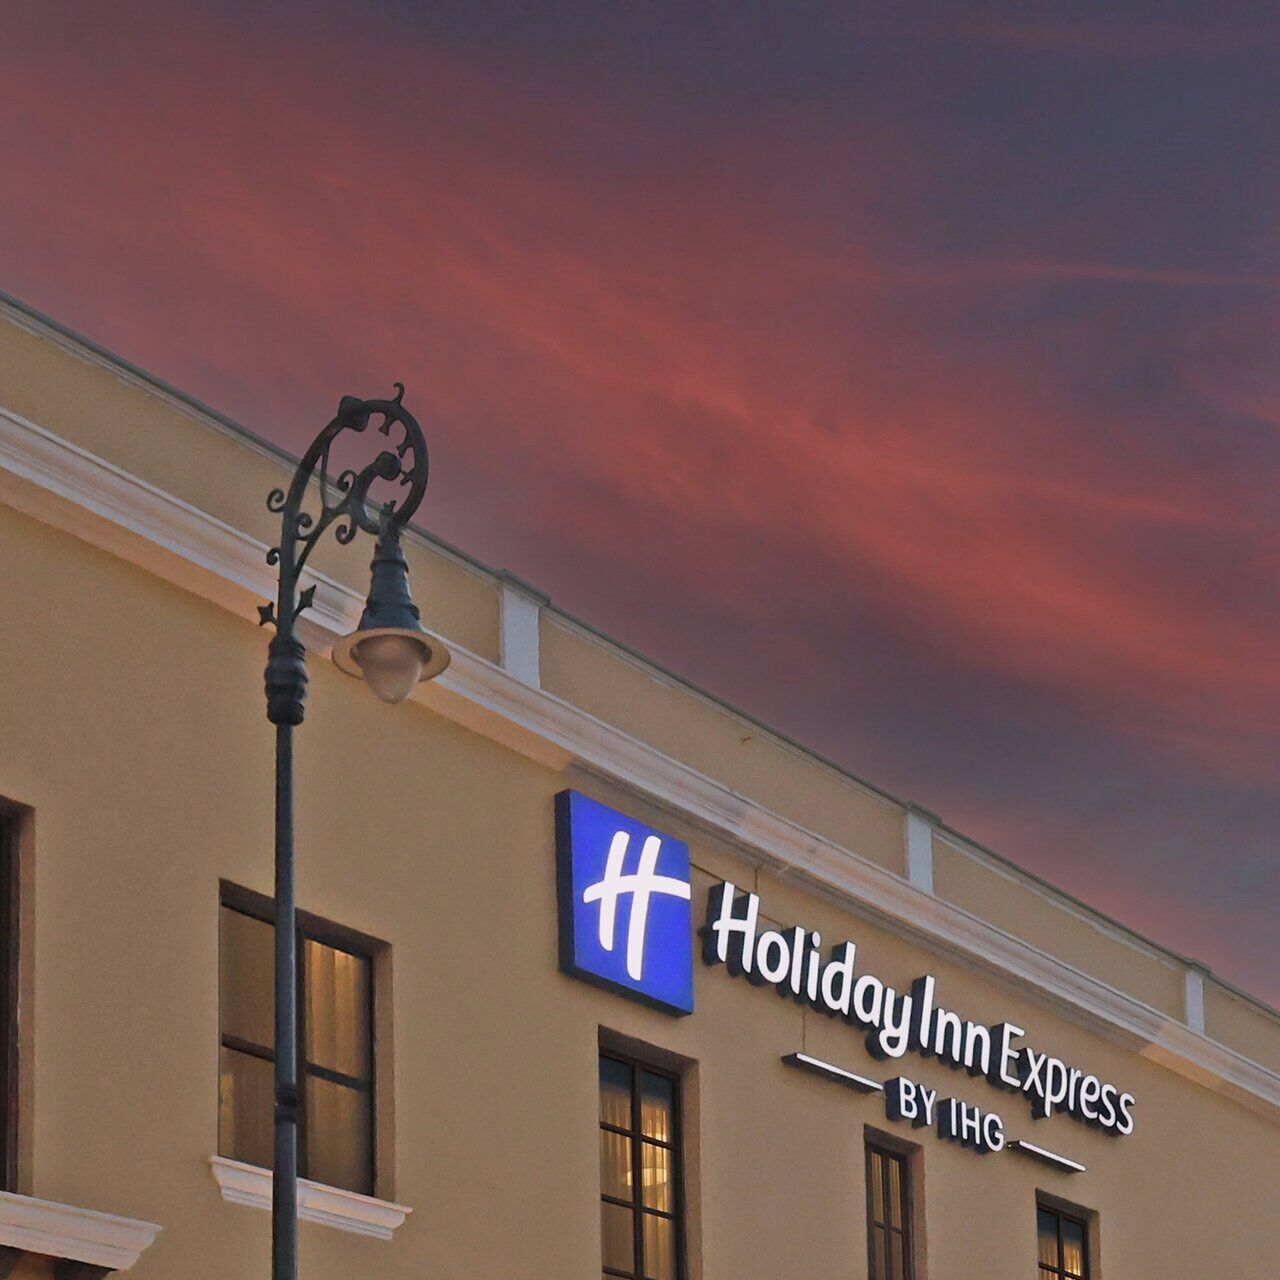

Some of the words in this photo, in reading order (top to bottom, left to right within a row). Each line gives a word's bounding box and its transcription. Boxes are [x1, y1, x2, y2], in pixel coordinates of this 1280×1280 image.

[712, 881, 913, 1058] Holiday
[920, 975, 990, 1075] Inn
[1000, 1023, 1136, 1136] Express
[899, 1076, 937, 1126] BY
[950, 1097, 1005, 1152] IHG
